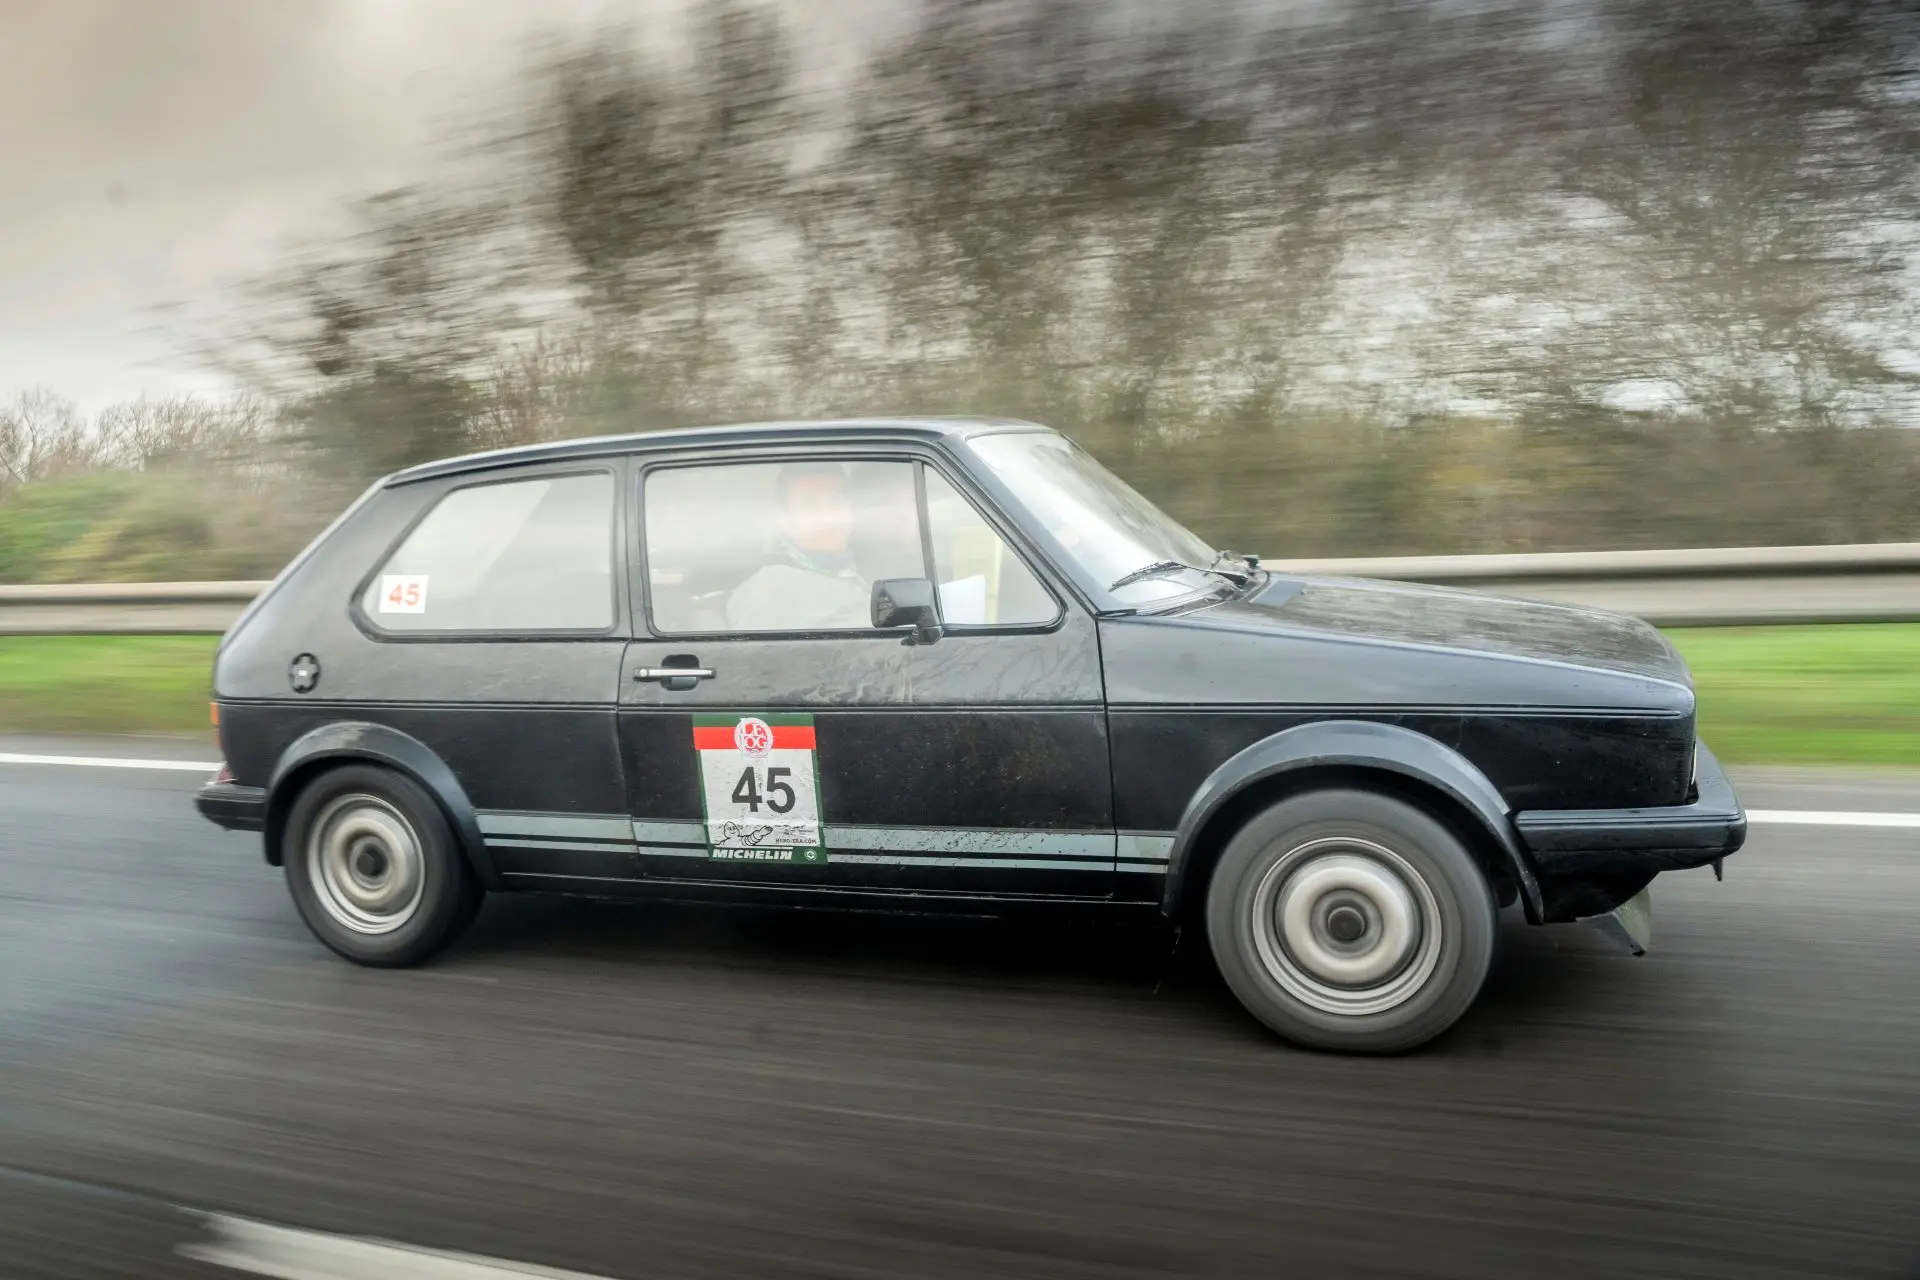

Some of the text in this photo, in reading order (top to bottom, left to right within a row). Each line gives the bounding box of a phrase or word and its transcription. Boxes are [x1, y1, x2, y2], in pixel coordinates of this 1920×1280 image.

[388, 583, 420, 606] 45
[744, 722, 764, 736] LE
[732, 766, 796, 814] 45
[712, 848, 793, 860] MICHELIN
